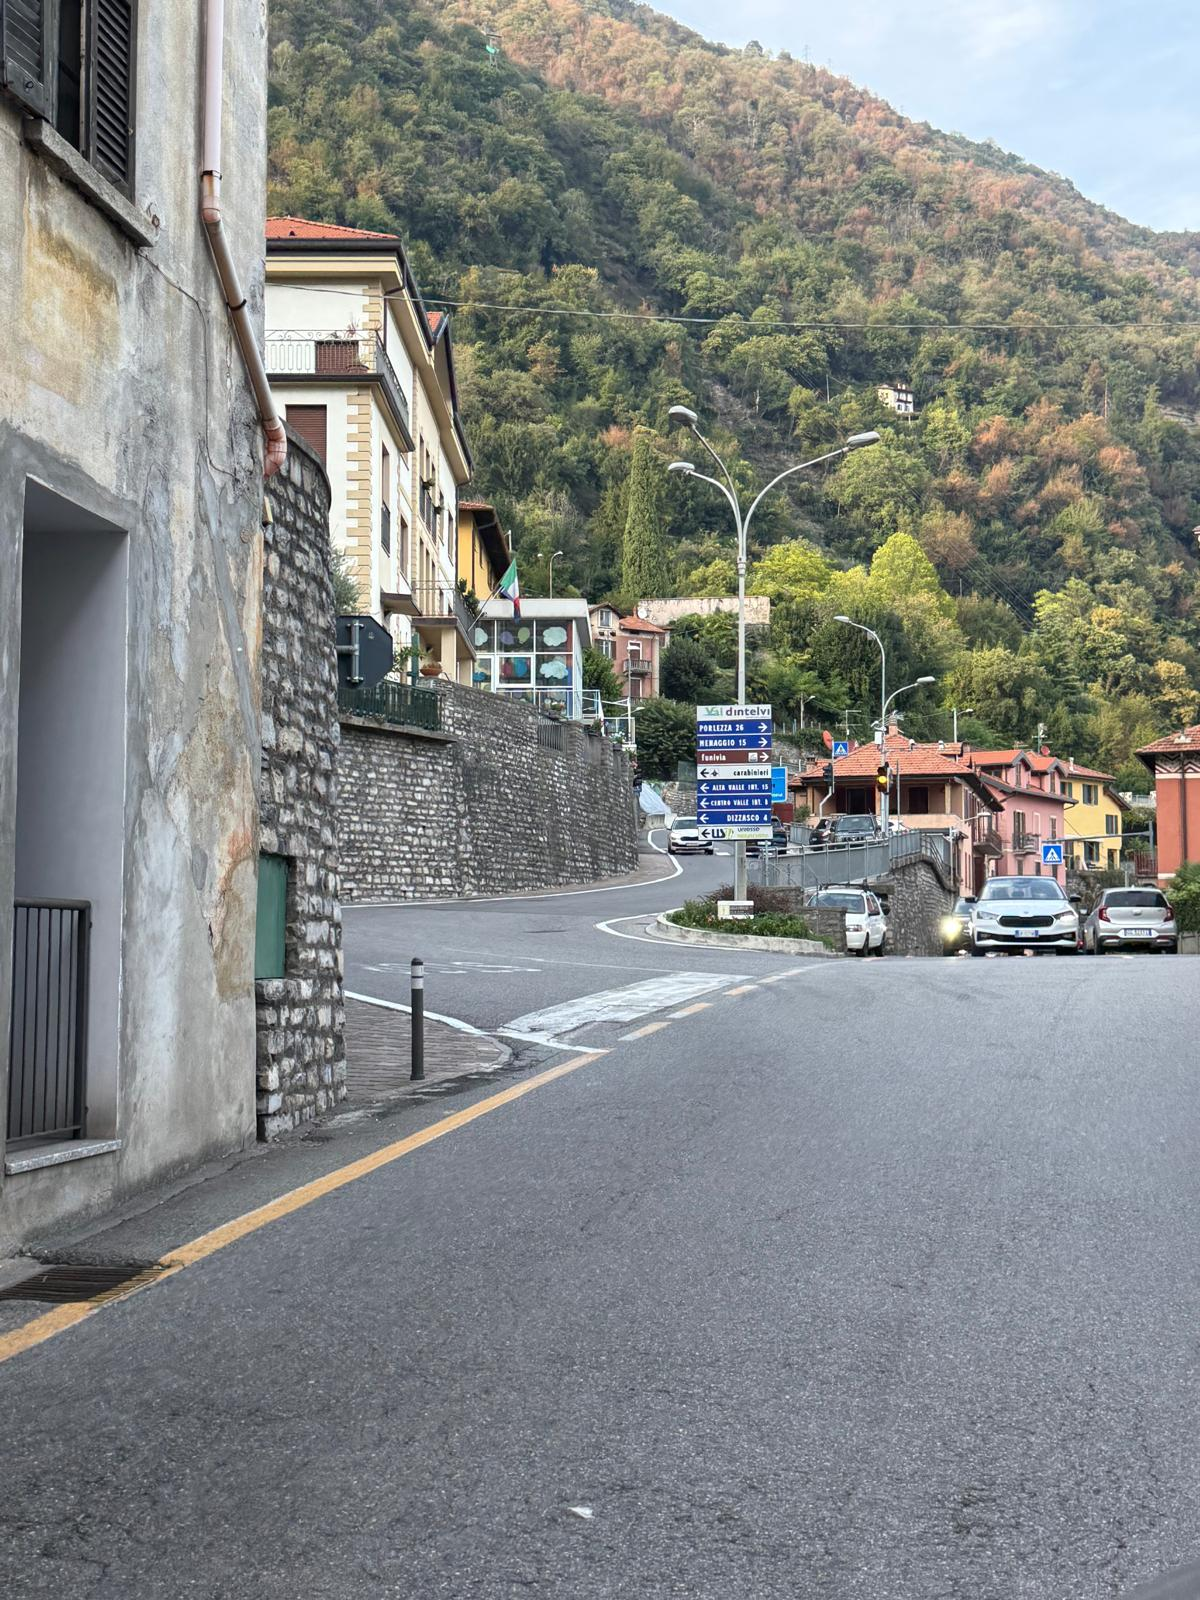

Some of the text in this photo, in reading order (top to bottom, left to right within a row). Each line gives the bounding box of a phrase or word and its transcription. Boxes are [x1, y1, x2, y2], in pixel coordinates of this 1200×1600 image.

[699, 724, 732, 732] PORLEZZA
[699, 739, 735, 747] MENAGGIO
[727, 814, 759, 822] DIZZASCO
